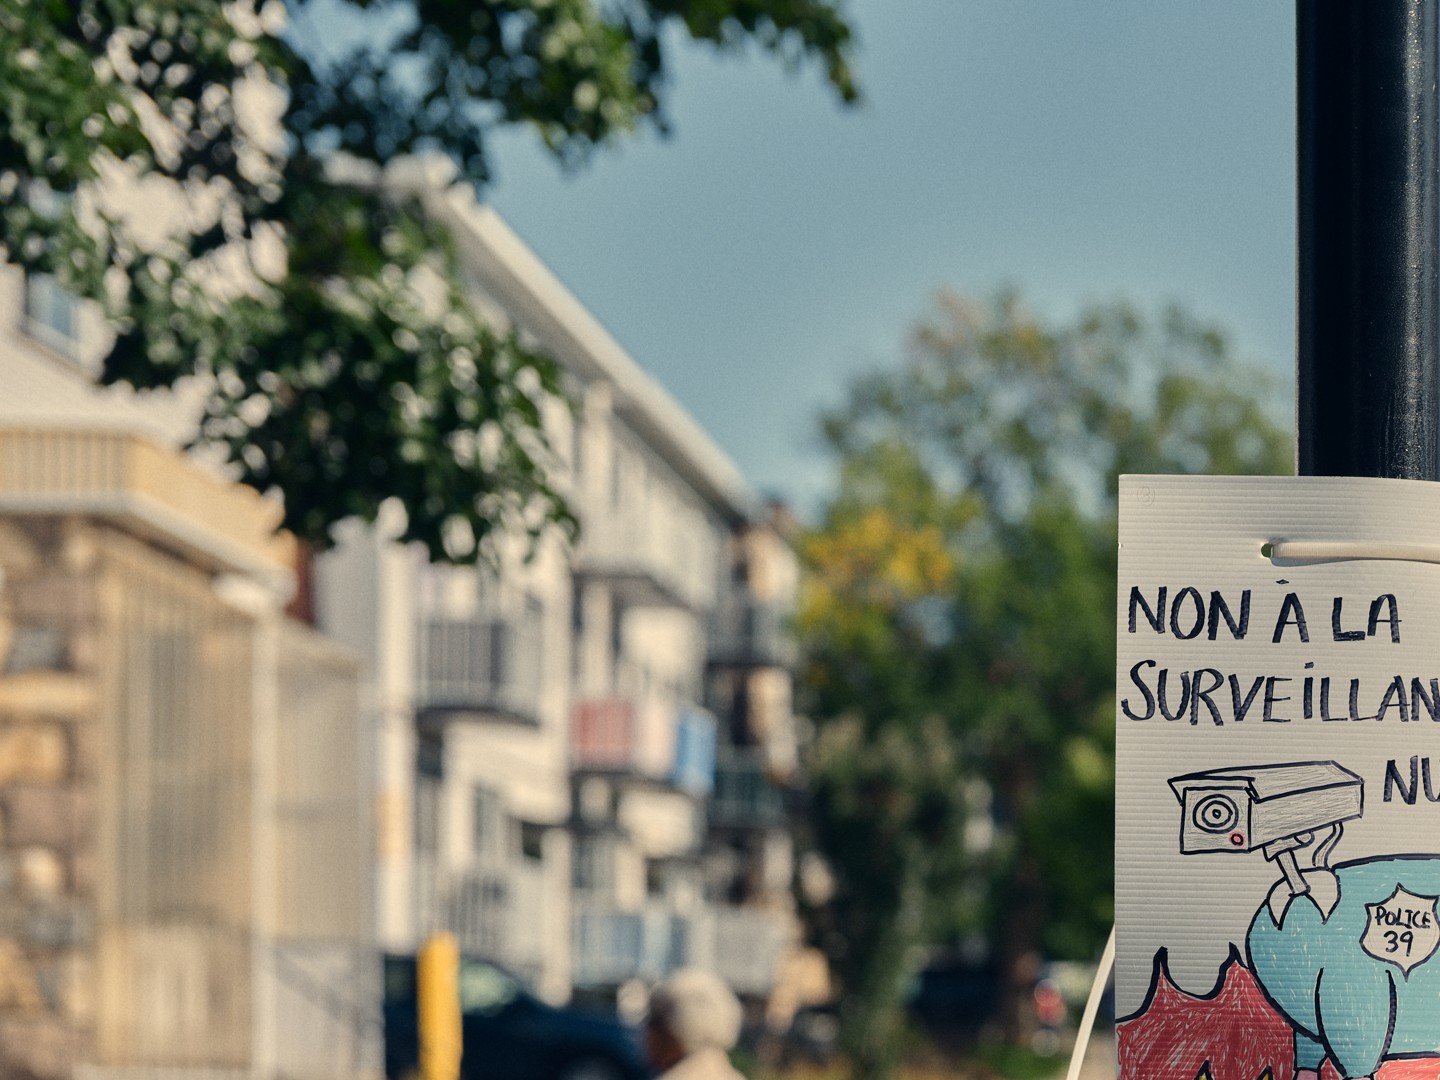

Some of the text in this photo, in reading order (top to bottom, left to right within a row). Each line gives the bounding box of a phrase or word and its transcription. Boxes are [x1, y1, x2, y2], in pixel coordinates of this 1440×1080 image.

[1128, 579, 1402, 643] NON À LA
[1375, 905, 1431, 929] POLICE
[1384, 930, 1413, 957] 39
